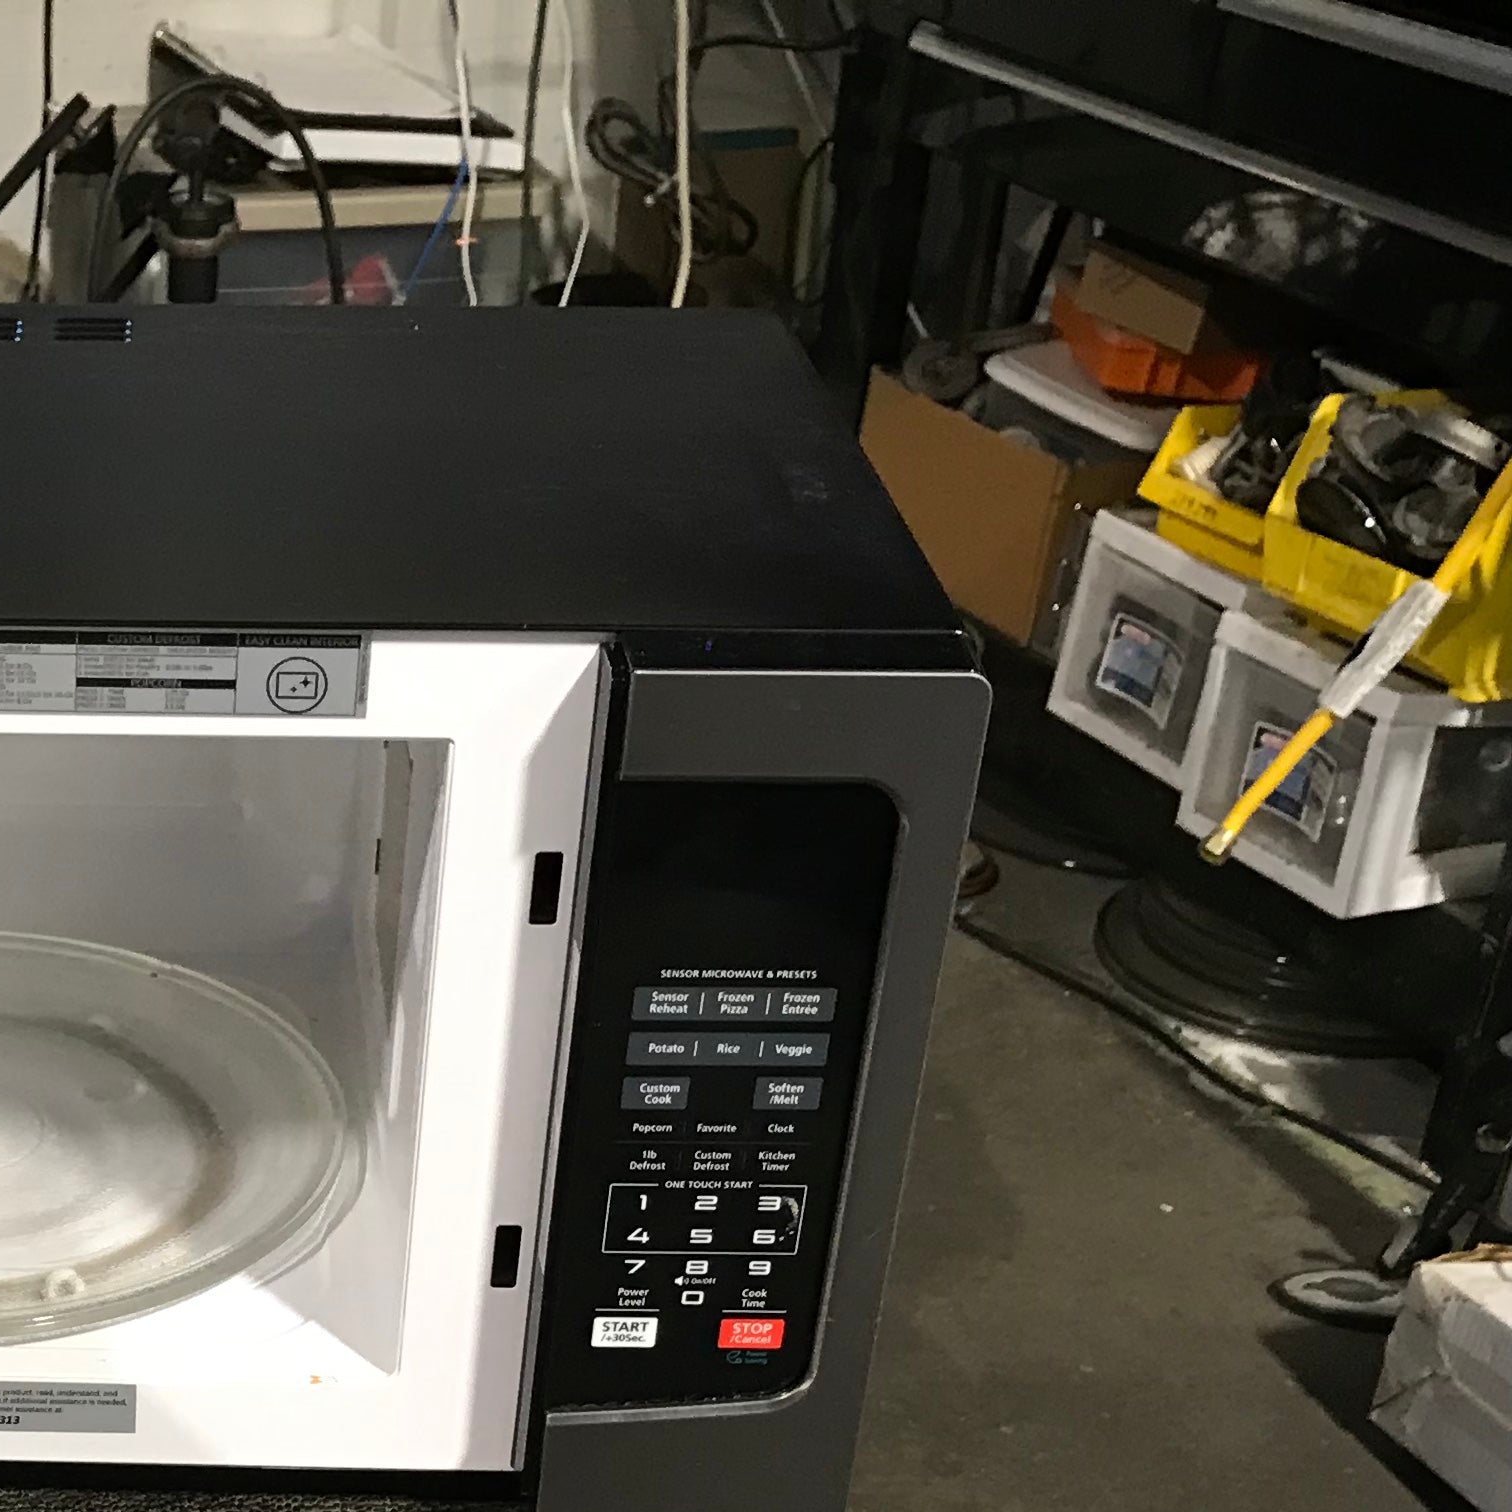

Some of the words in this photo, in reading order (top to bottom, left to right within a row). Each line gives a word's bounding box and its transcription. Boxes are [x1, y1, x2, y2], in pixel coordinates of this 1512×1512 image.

[273, 636, 308, 645] CLEAN
[660, 969, 700, 978] SENSOR
[702, 969, 764, 979] MICROWAVE
[766, 970, 774, 979] &
[776, 970, 818, 980] PRESETS
[652, 991, 689, 1002] Sensor
[717, 992, 754, 1002] Frozen
[783, 992, 821, 1003] Frozen
[649, 1003, 688, 1014] Reheat
[720, 1004, 748, 1014] Pizza
[782, 1004, 818, 1015] Entrée
[648, 1042, 685, 1054] Potato
[717, 1043, 741, 1054] Rice
[776, 1044, 812, 1057] Veggie
[640, 1083, 680, 1094] Custom
[768, 1082, 804, 1094] Soften
[644, 1094, 672, 1104] Cook
[769, 1095, 799, 1105] /Melt
[632, 1123, 673, 1134] Popcorn
[696, 1123, 737, 1134] Favorite
[768, 1124, 794, 1133] Clock
[642, 1150, 657, 1159] 1lb
[694, 1151, 732, 1160] Custom
[758, 1151, 796, 1160] Kitchen
[629, 1161, 666, 1170] Defrost
[693, 1162, 730, 1171] Defrost
[762, 1162, 790, 1171] Timer
[664, 1180, 687, 1189] ONE
[688, 1180, 722, 1189] TOUCH
[724, 1181, 754, 1189] START
[640, 1194, 648, 1211] 1
[694, 1195, 718, 1211] 2
[757, 1196, 782, 1211] 3
[626, 1228, 650, 1244] 4
[689, 1228, 713, 1244] 5
[752, 1229, 776, 1244] 6
[624, 1259, 646, 1275] 7
[685, 1260, 709, 1275] 8
[748, 1260, 772, 1276] 9
[618, 1288, 650, 1296] Power
[680, 1290, 705, 1305] 0
[741, 1288, 768, 1298] Cook
[618, 1298, 646, 1307] Level
[741, 1299, 766, 1308] Time
[602, 1321, 649, 1332] START
[732, 1323, 774, 1334] STOP
[730, 1335, 772, 1344] /Cancel
